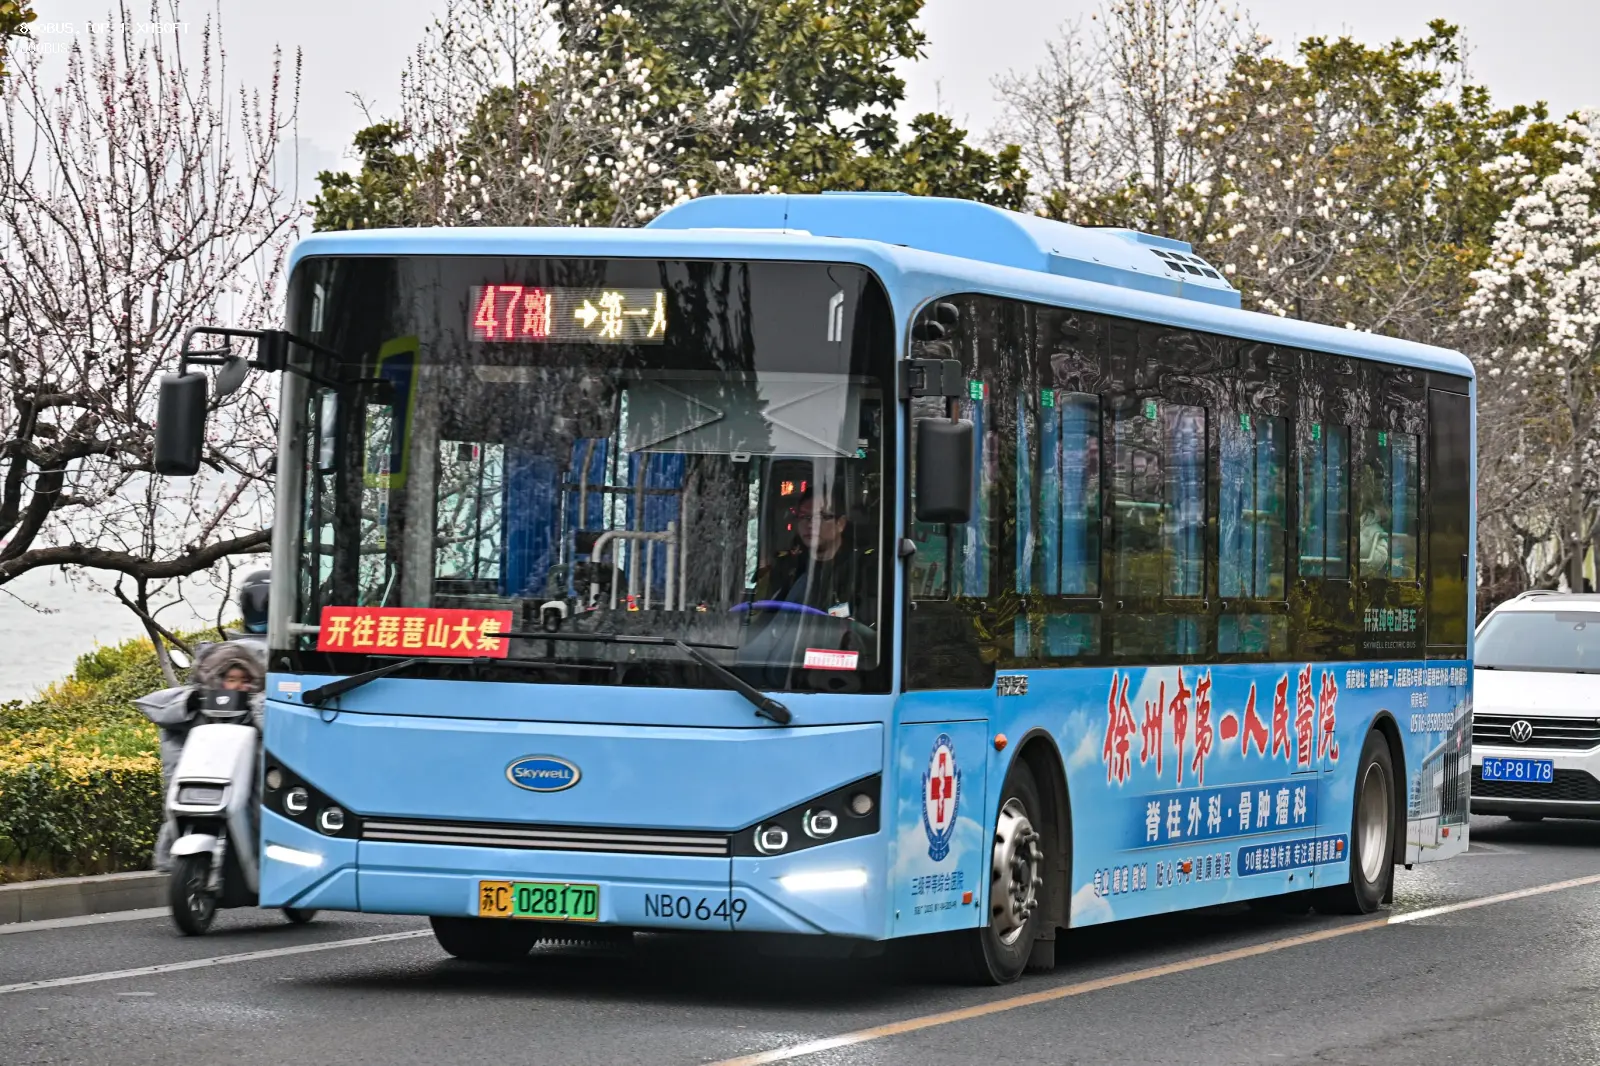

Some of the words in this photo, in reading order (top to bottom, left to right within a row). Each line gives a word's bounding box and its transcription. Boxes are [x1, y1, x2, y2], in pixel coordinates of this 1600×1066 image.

[326, 614, 502, 651] 开往琵琶山大集
[1407, 641, 1416, 649] BUS
[1245, 845, 1291, 871] 90载经验传承
[1094, 868, 1110, 898] 专业
[645, 893, 747, 922] NB0649
